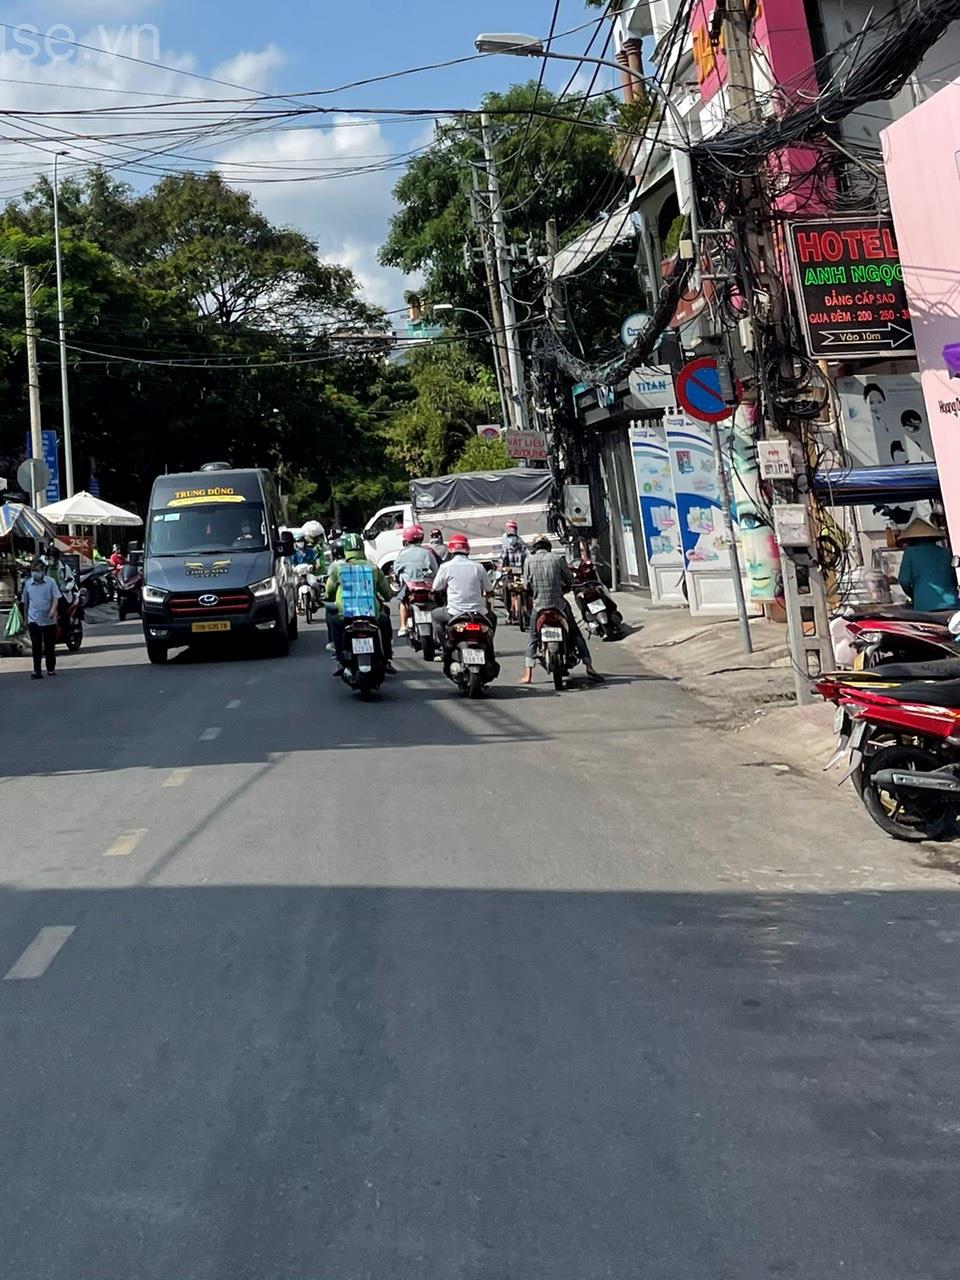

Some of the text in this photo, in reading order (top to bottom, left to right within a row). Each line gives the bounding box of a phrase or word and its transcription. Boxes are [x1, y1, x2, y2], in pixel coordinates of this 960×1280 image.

[798, 228, 899, 262] HOTEL
[805, 267, 847, 285] ANH
[876, 293, 896, 305] SAO
[809, 313, 830, 324] QUA
[862, 332, 881, 341] 10m
[636, 381, 666, 392] TITAN
[175, 488, 206, 499] TRUNG
[70, 538, 89, 548] 25K
